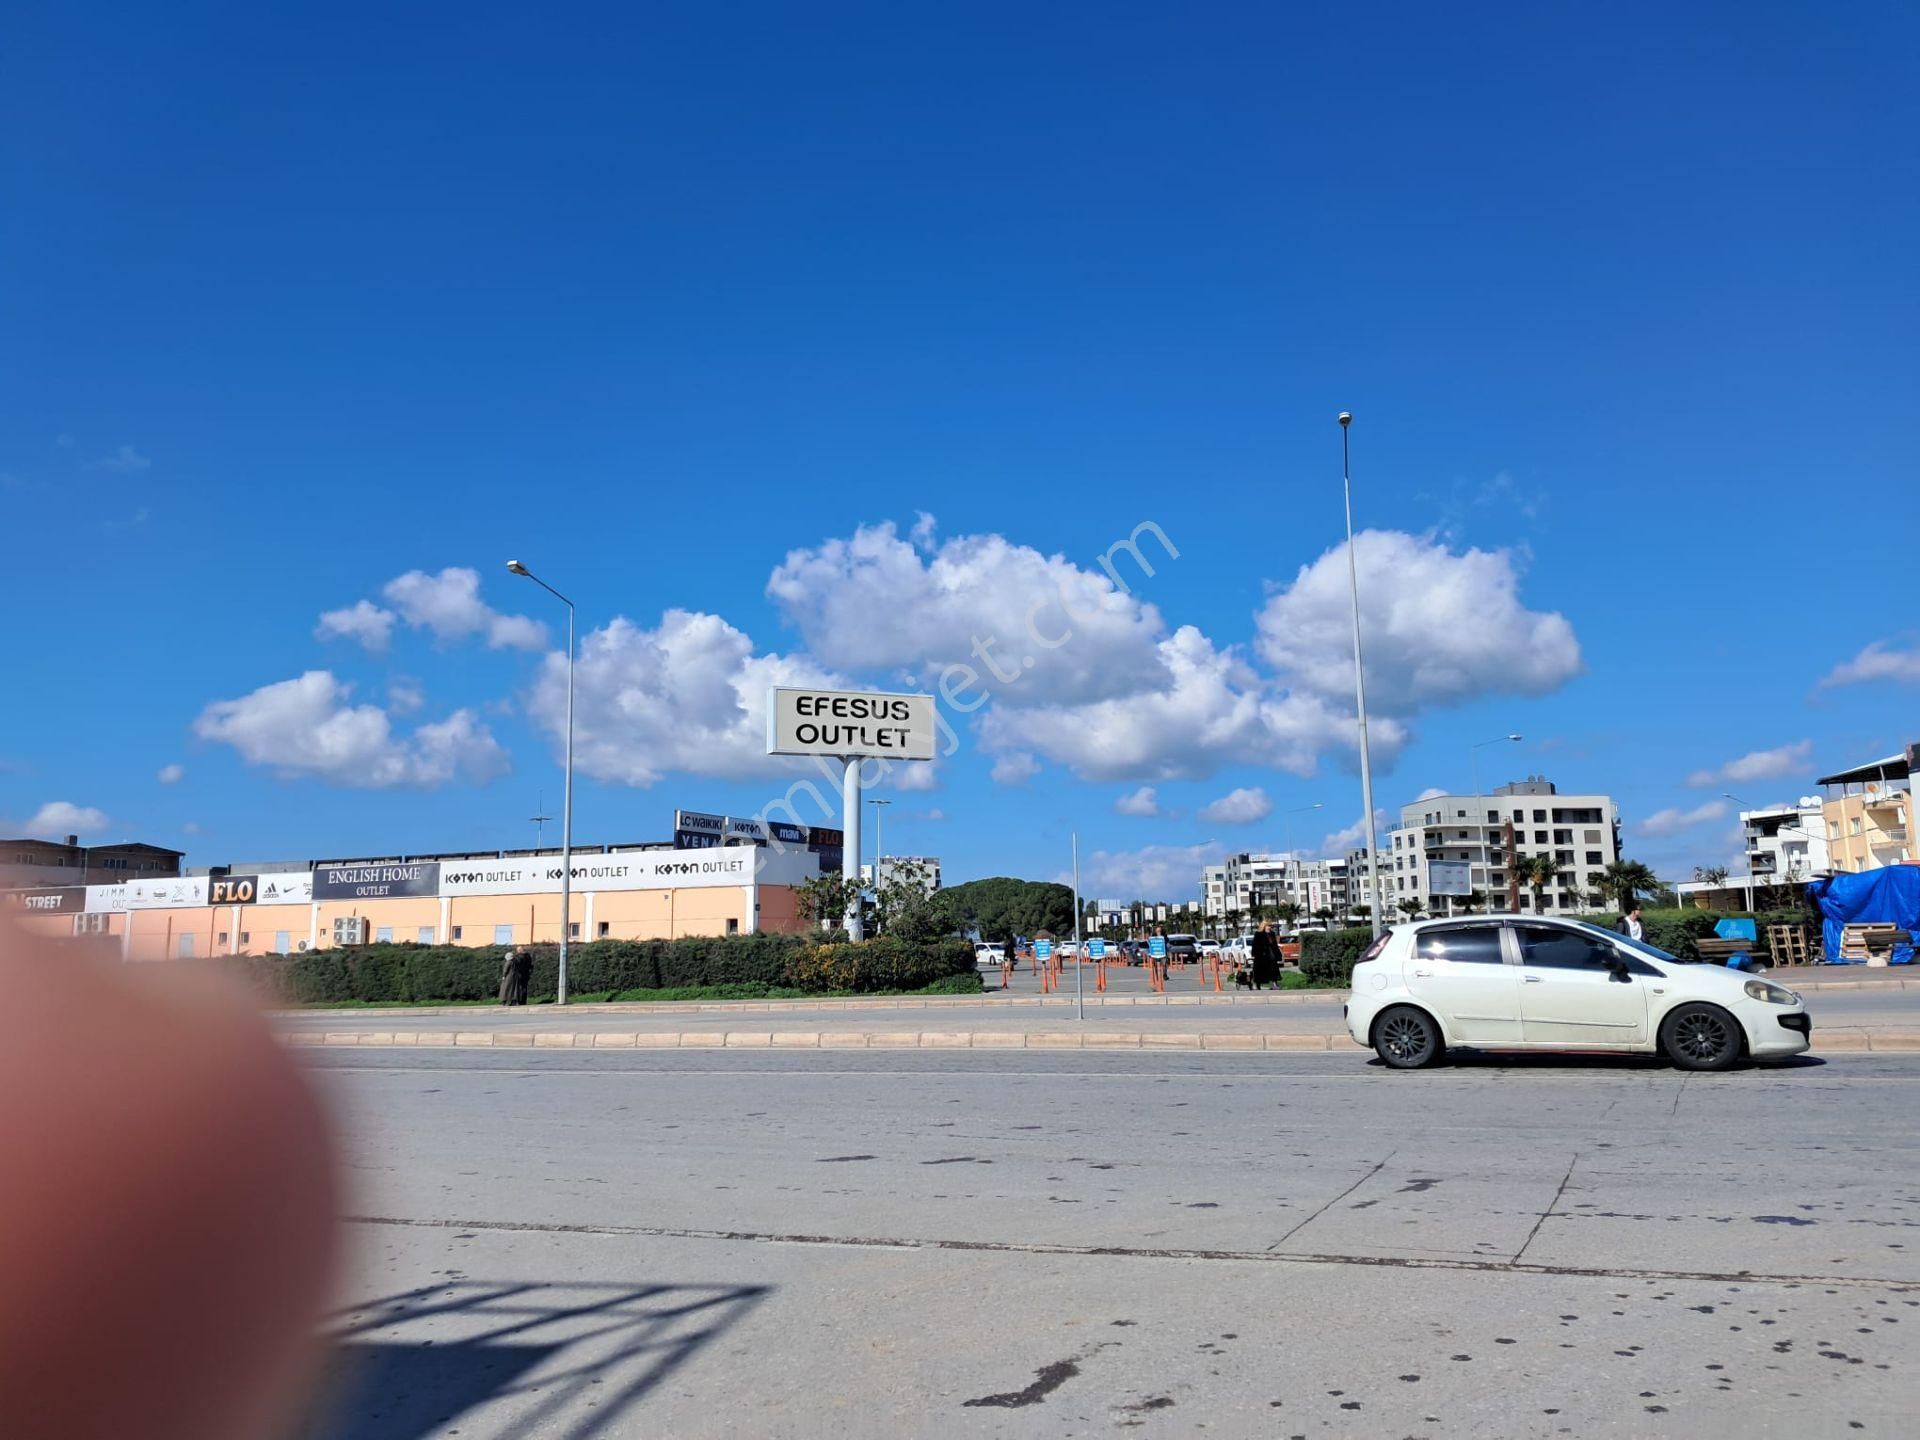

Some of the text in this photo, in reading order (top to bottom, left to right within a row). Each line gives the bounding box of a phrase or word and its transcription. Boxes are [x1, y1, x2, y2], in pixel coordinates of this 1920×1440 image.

[796, 696, 910, 721] EFESUS
[796, 723, 911, 748] OUTLET
[680, 815, 691, 826] LC
[779, 828, 800, 840] mavi
[818, 830, 839, 845] FLO
[546, 866, 629, 880] KOON OUTLET
[655, 860, 744, 875] KOTON OUTLET
[328, 867, 421, 884] ENGLISH HOME
[445, 870, 522, 884] KOTON OUTLET
[212, 880, 253, 902] FLO
[356, 885, 391, 896] OUTLET
[25, 895, 63, 909] STREET
